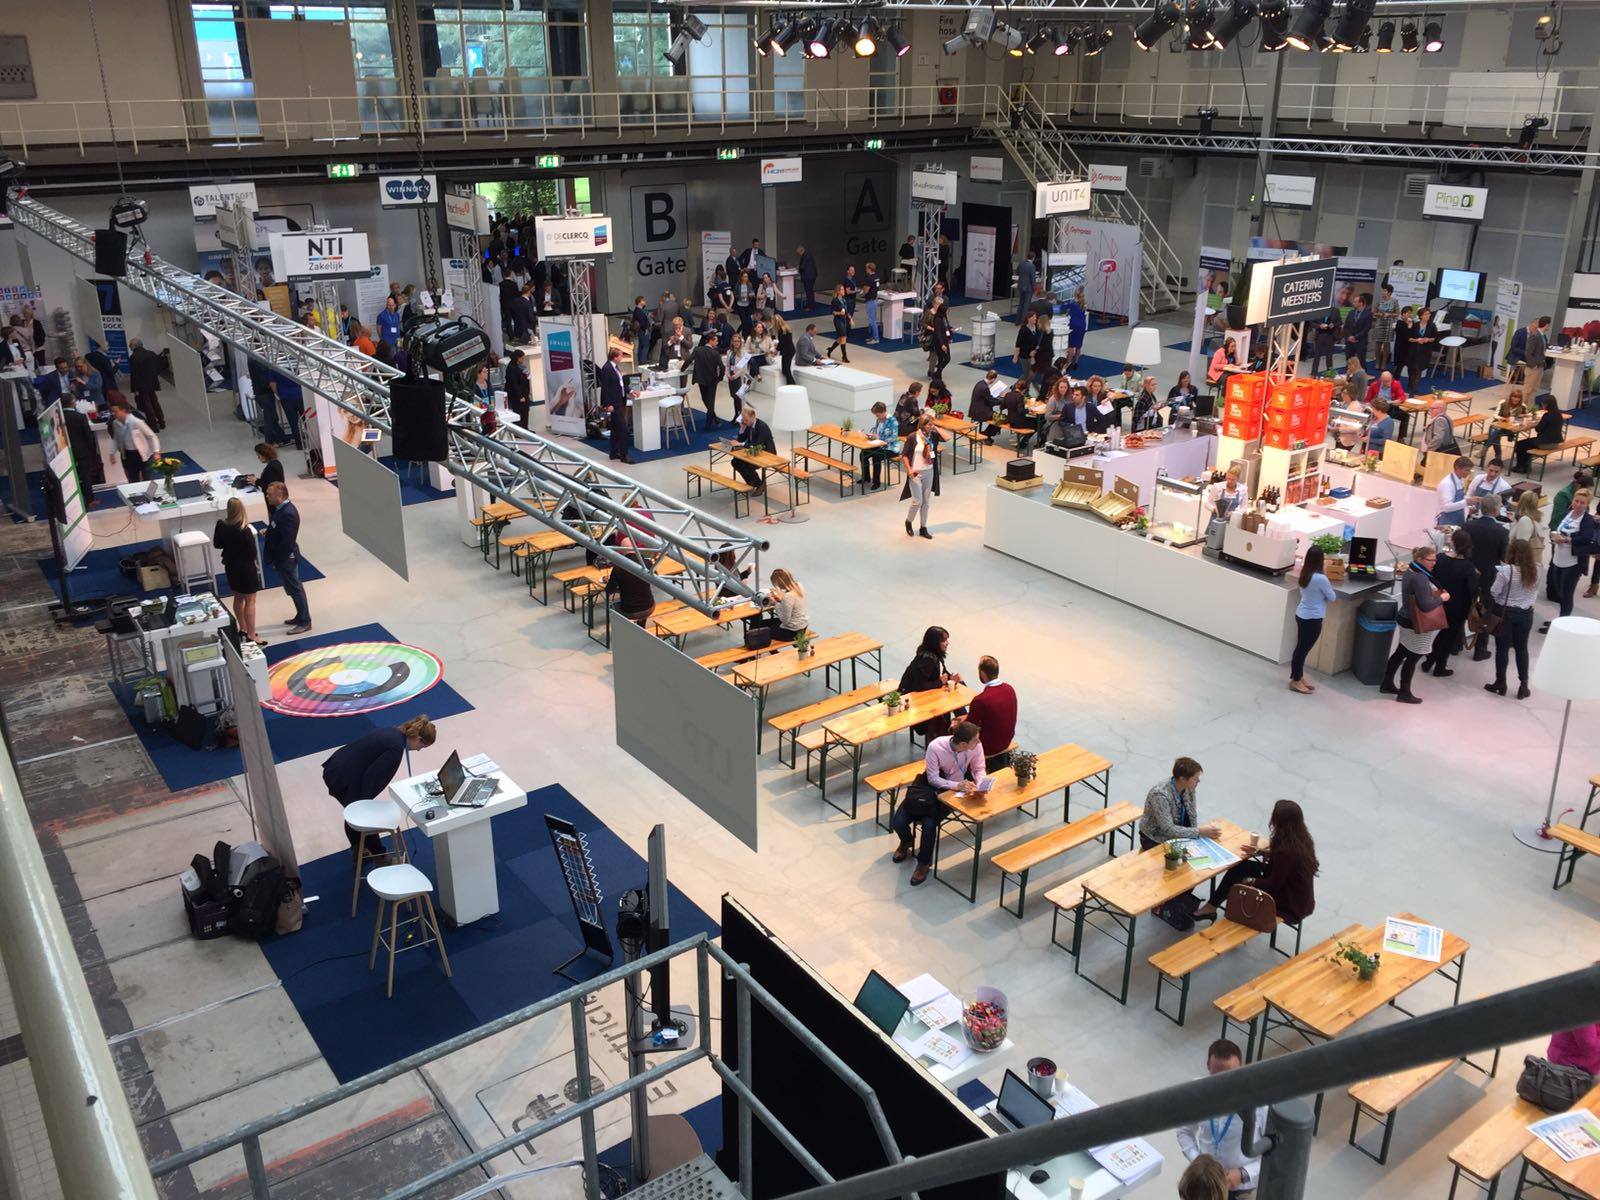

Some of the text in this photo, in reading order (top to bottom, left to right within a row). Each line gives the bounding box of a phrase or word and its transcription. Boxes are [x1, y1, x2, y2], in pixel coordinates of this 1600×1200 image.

[204, 191, 255, 202] TALENTSOFT
[387, 184, 430, 194] WINNOCK
[1051, 186, 1086, 203] UNIT4
[850, 177, 884, 225] A
[1435, 191, 1460, 207] Ping
[643, 192, 677, 243] B
[307, 237, 343, 257] NTI
[846, 236, 887, 256] Gate
[308, 261, 344, 272] Zakelijk
[636, 256, 687, 277] Gate
[1282, 277, 1325, 294] CATERING
[1280, 291, 1323, 308] MEESTERS
